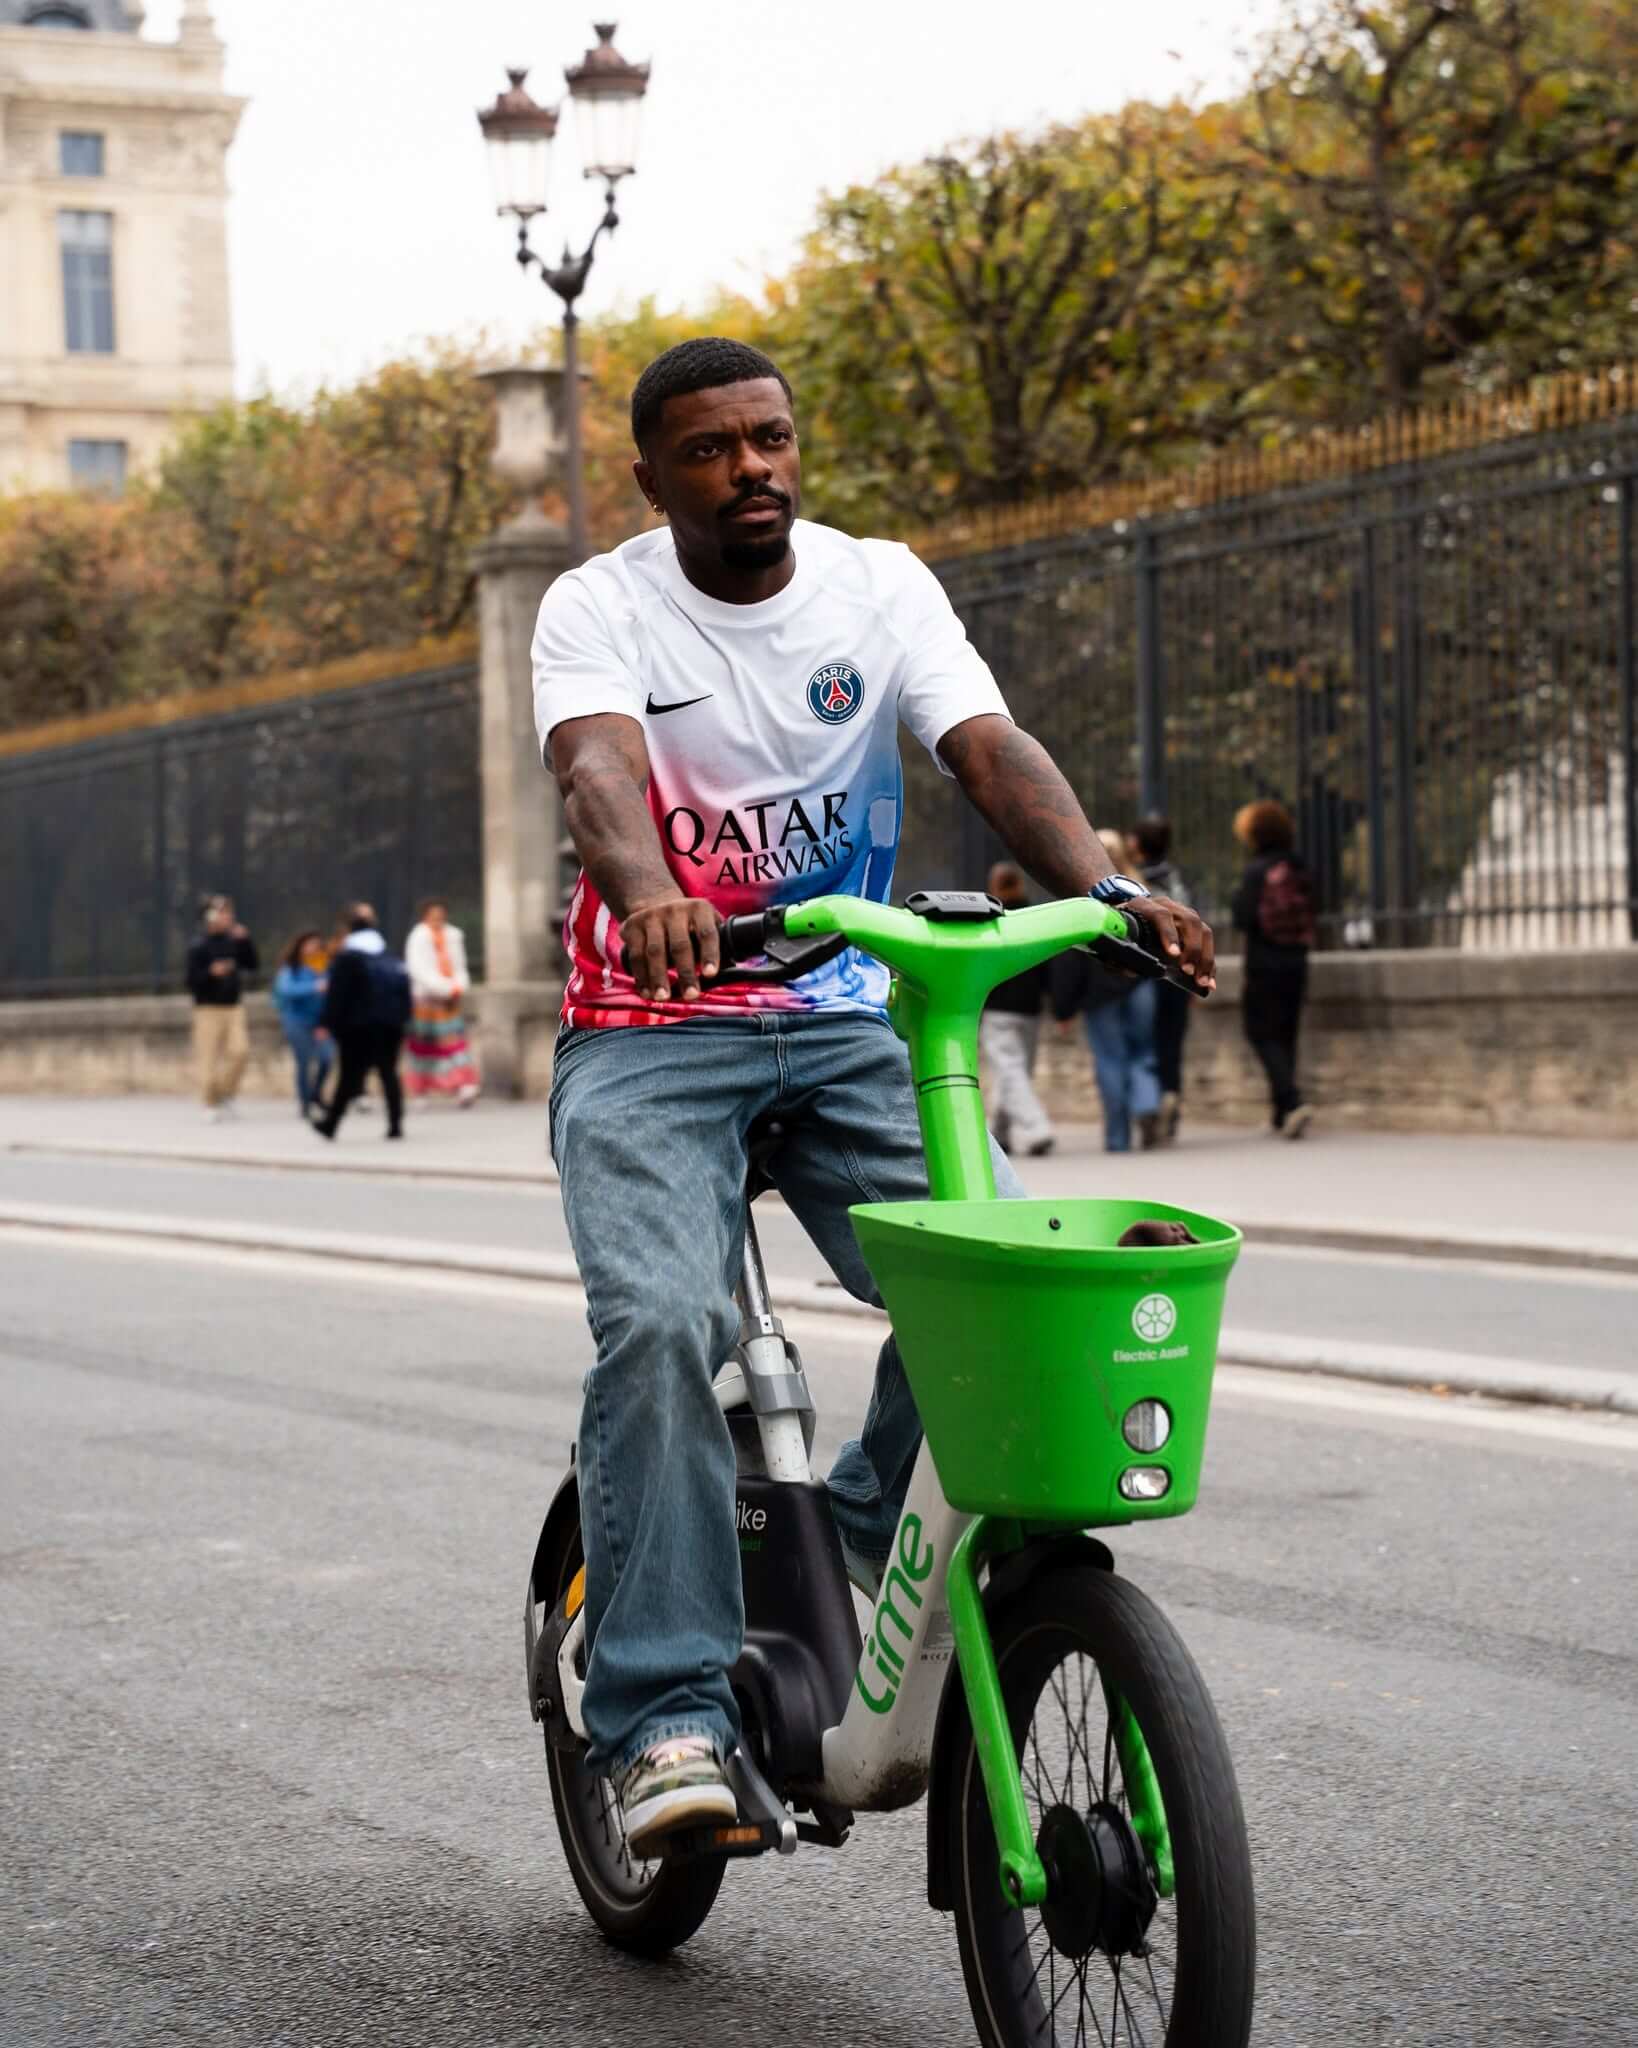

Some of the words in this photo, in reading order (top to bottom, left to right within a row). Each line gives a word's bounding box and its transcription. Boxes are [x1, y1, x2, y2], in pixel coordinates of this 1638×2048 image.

[815, 668, 852, 685] PARIS
[664, 792, 848, 867] QATAR
[716, 830, 854, 885] AIRWAYS
[1113, 1349, 1158, 1363] Electric
[1159, 1344, 1189, 1359] Assist
[736, 1500, 767, 1531] ike
[856, 1512, 934, 1715] Lime
